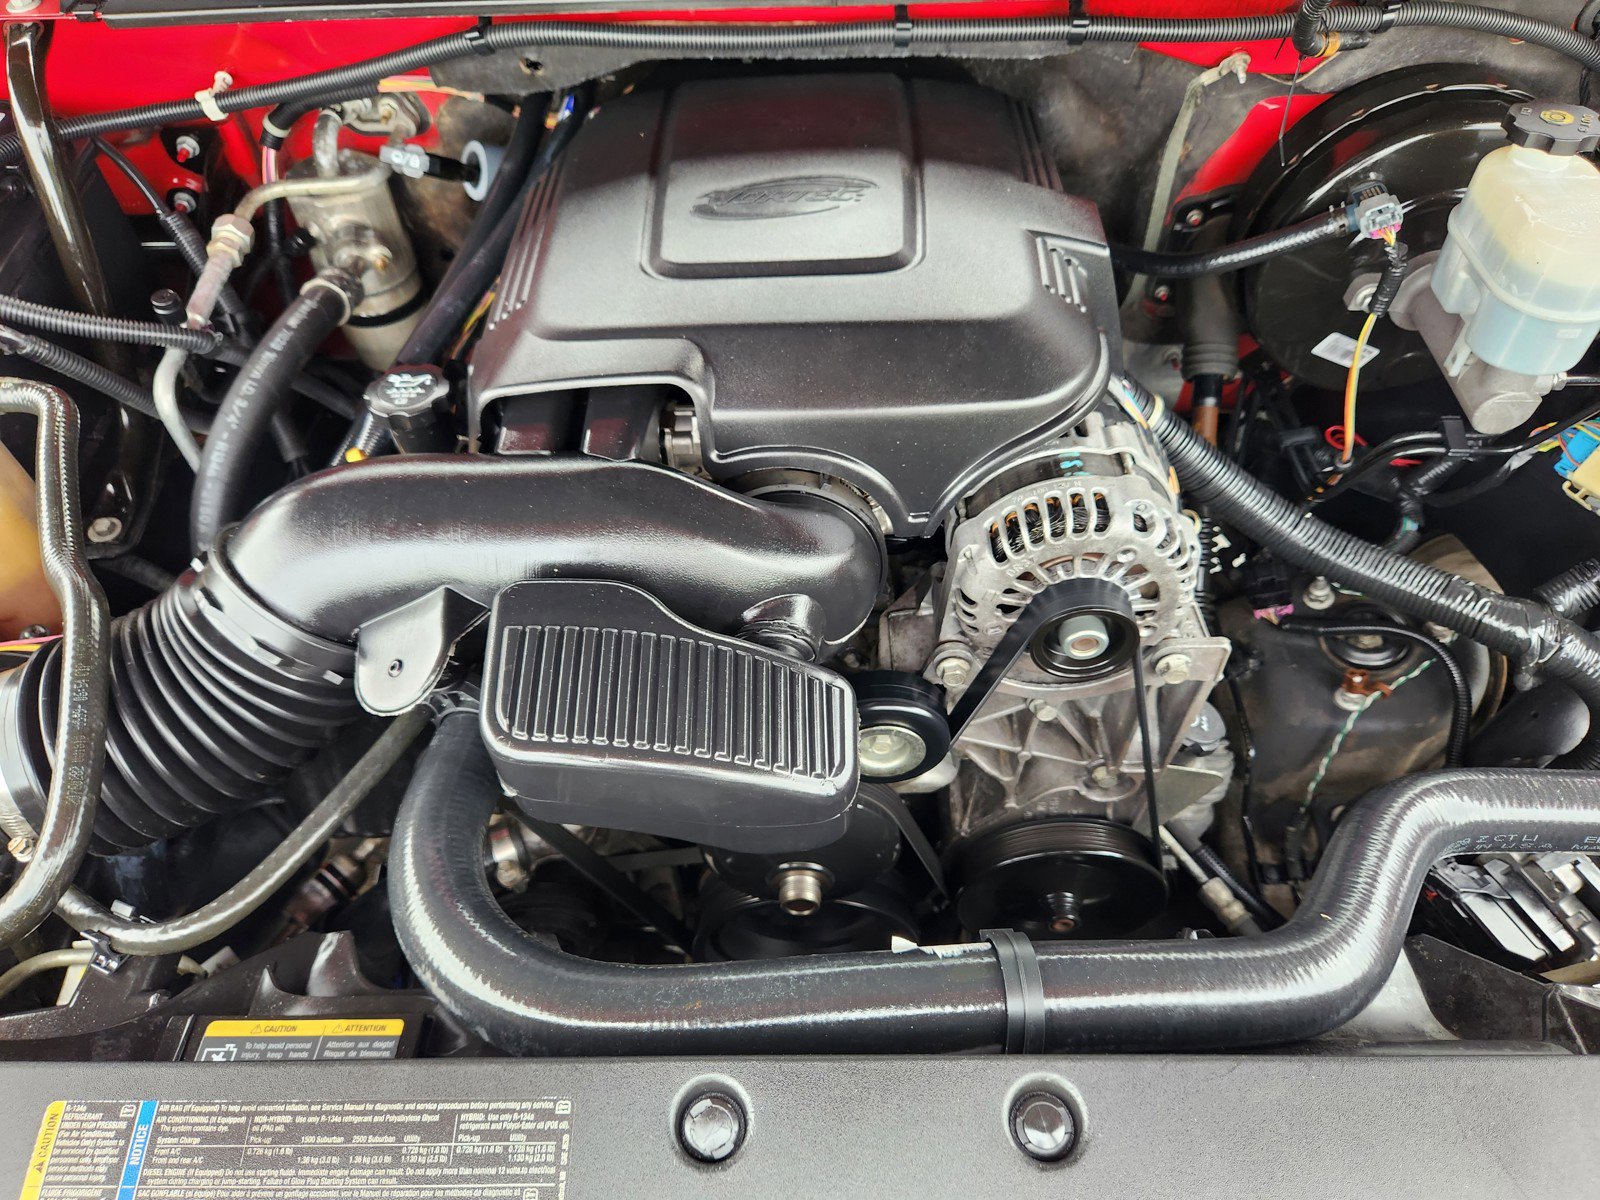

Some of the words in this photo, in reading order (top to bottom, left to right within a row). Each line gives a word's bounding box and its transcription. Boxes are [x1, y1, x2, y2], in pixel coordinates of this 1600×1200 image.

[254, 1042, 266, 1050] help
[267, 1042, 284, 1050] avoid
[285, 1042, 312, 1050] personal
[167, 1116, 209, 1124] CONDITIONING
[96, 1121, 128, 1129] PRESSURE
[40, 1113, 59, 1158] CAUTION
[129, 1124, 149, 1166] NOTICE
